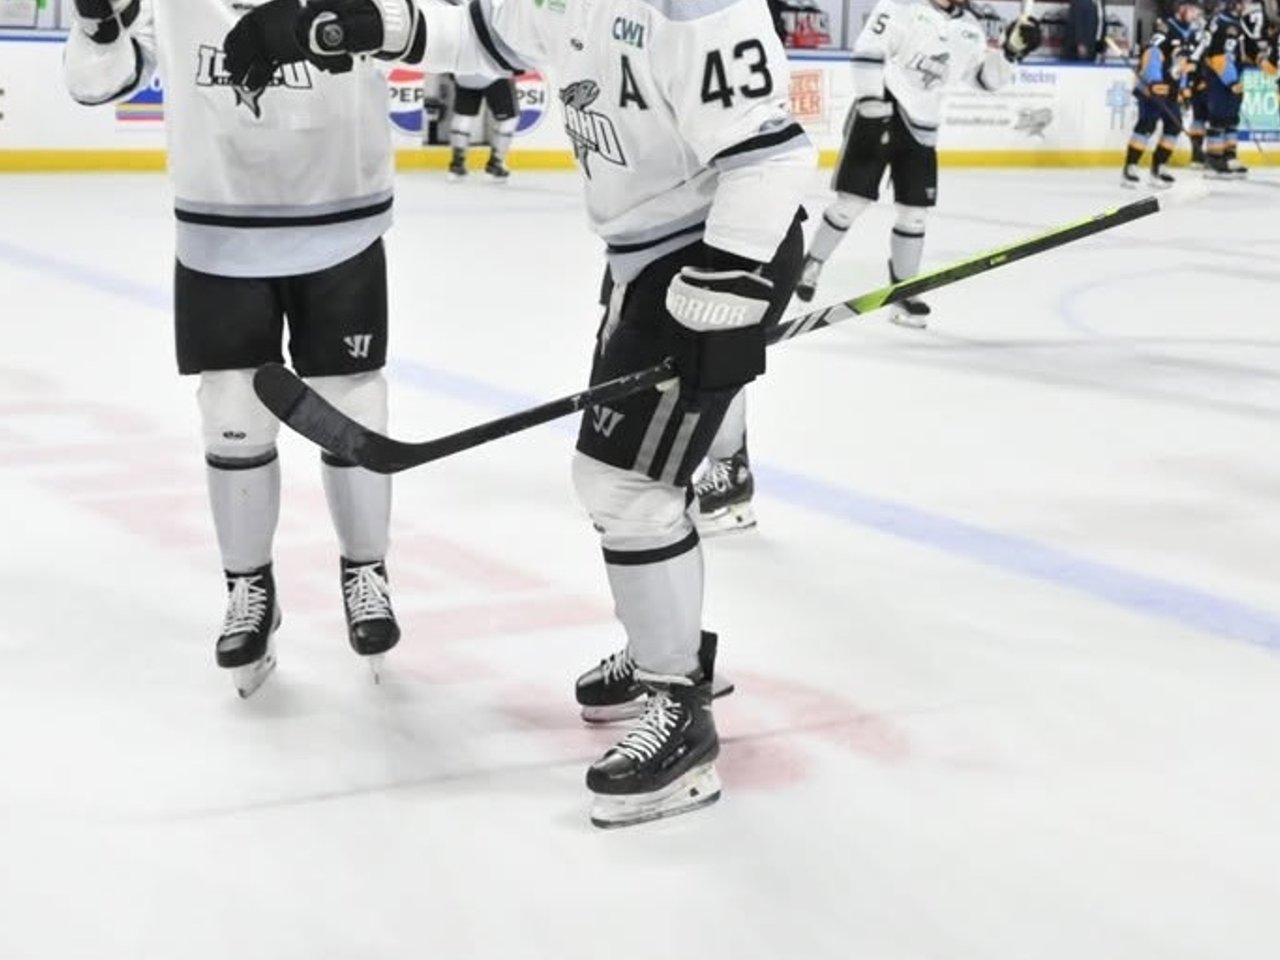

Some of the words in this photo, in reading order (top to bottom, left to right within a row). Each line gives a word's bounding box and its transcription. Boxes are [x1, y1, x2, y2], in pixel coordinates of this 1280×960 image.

[612, 15, 646, 50] CWI
[871, 12, 892, 35] 5
[618, 53, 650, 111] A
[700, 37, 775, 109] 43
